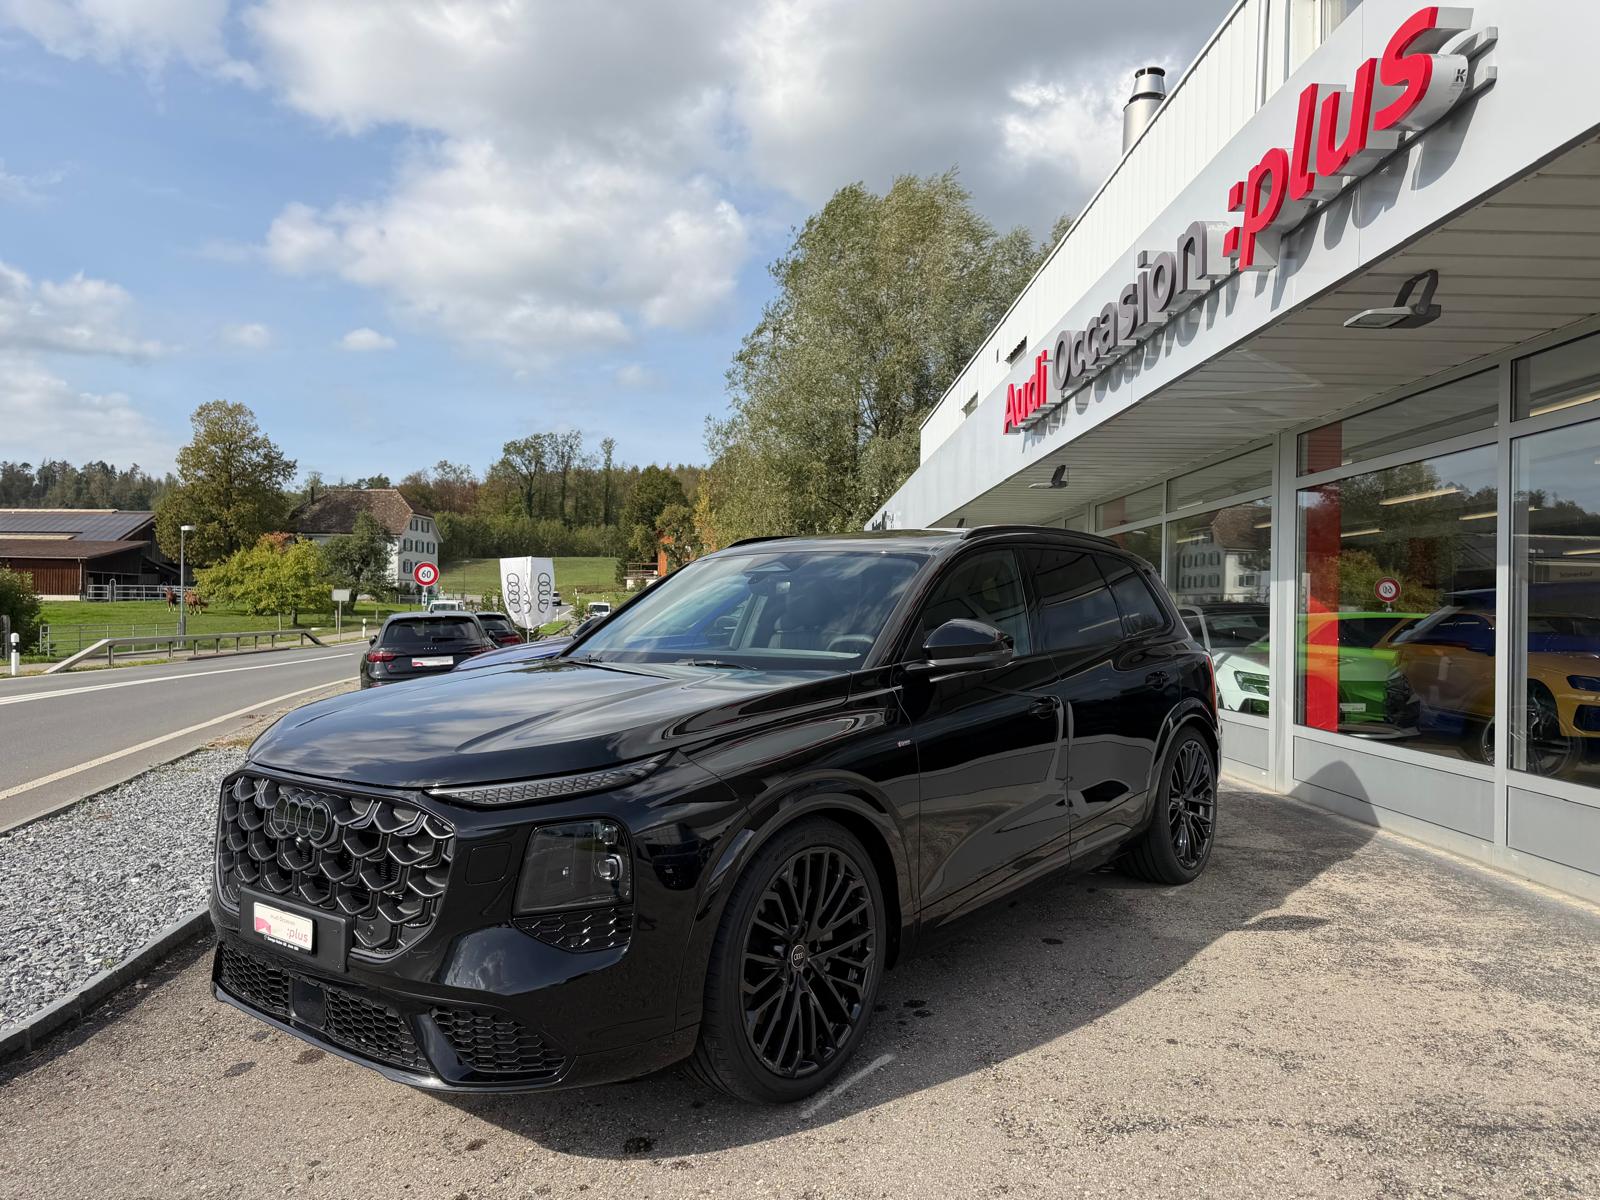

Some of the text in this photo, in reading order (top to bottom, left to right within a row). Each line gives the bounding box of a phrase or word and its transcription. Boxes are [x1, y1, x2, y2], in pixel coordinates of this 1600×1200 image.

[1003, 350, 1048, 435] Audi
[1052, 221, 1208, 391] Occasion
[421, 570, 432, 579] 60
